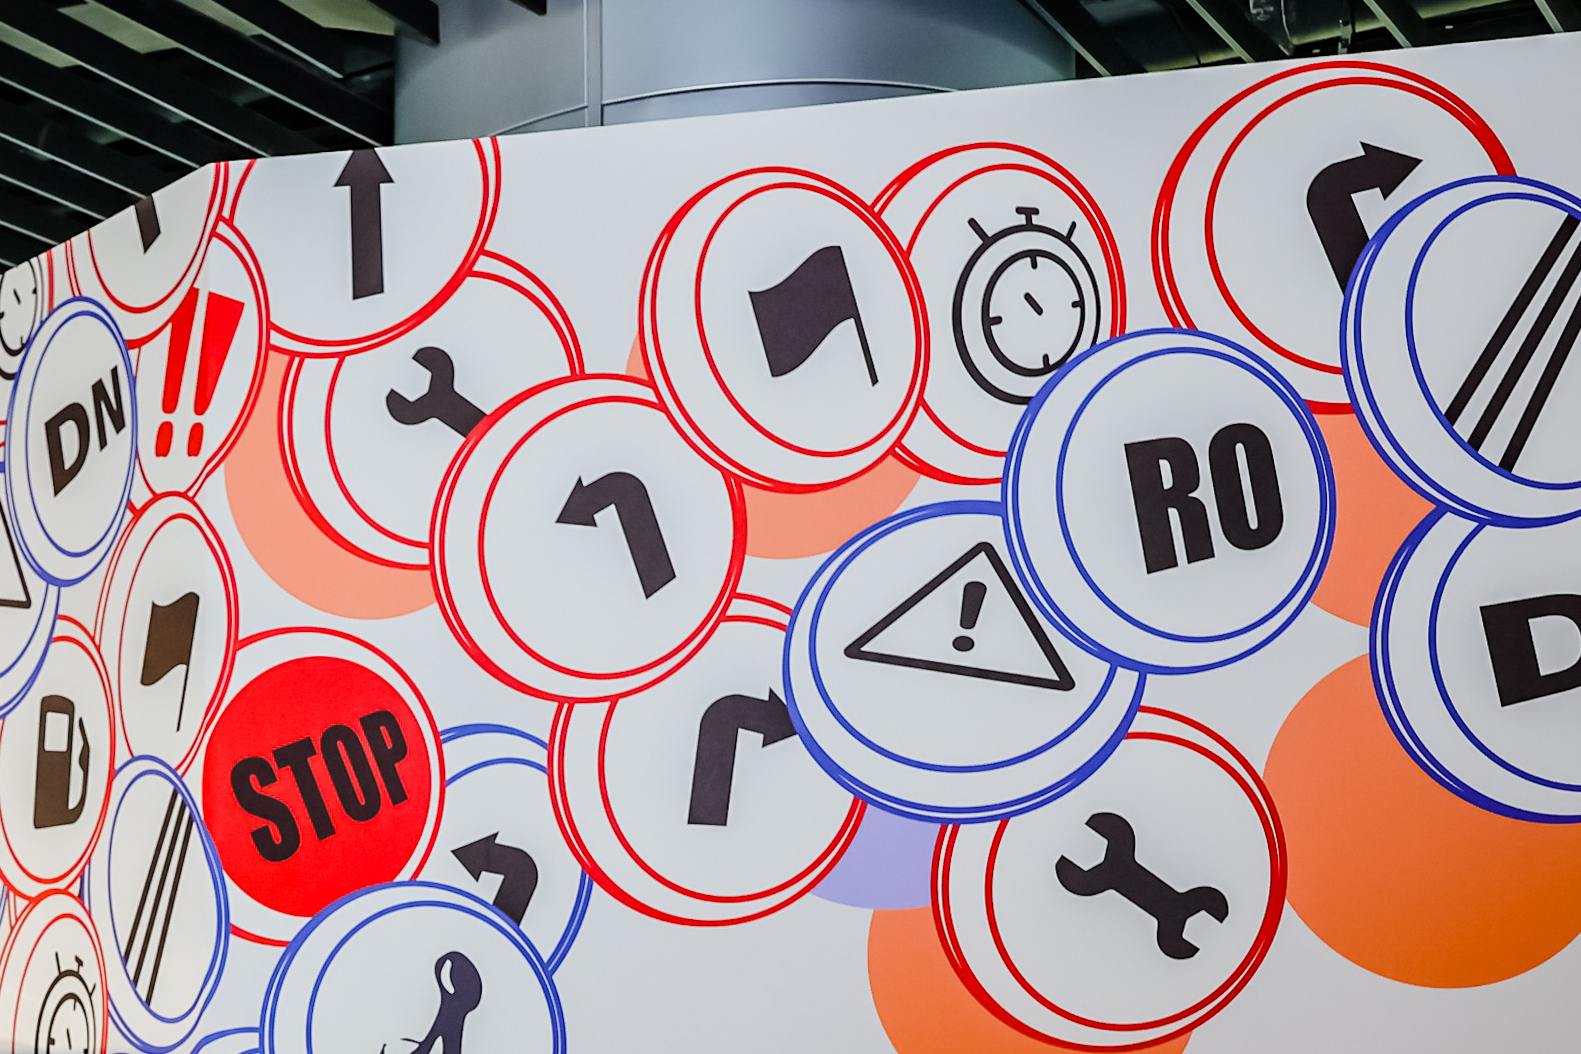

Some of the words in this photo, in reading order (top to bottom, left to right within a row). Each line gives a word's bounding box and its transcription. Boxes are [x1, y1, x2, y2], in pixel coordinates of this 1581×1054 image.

[45, 367, 127, 496] DN
[1123, 422, 1285, 575] RO
[230, 709, 411, 864] STOP
